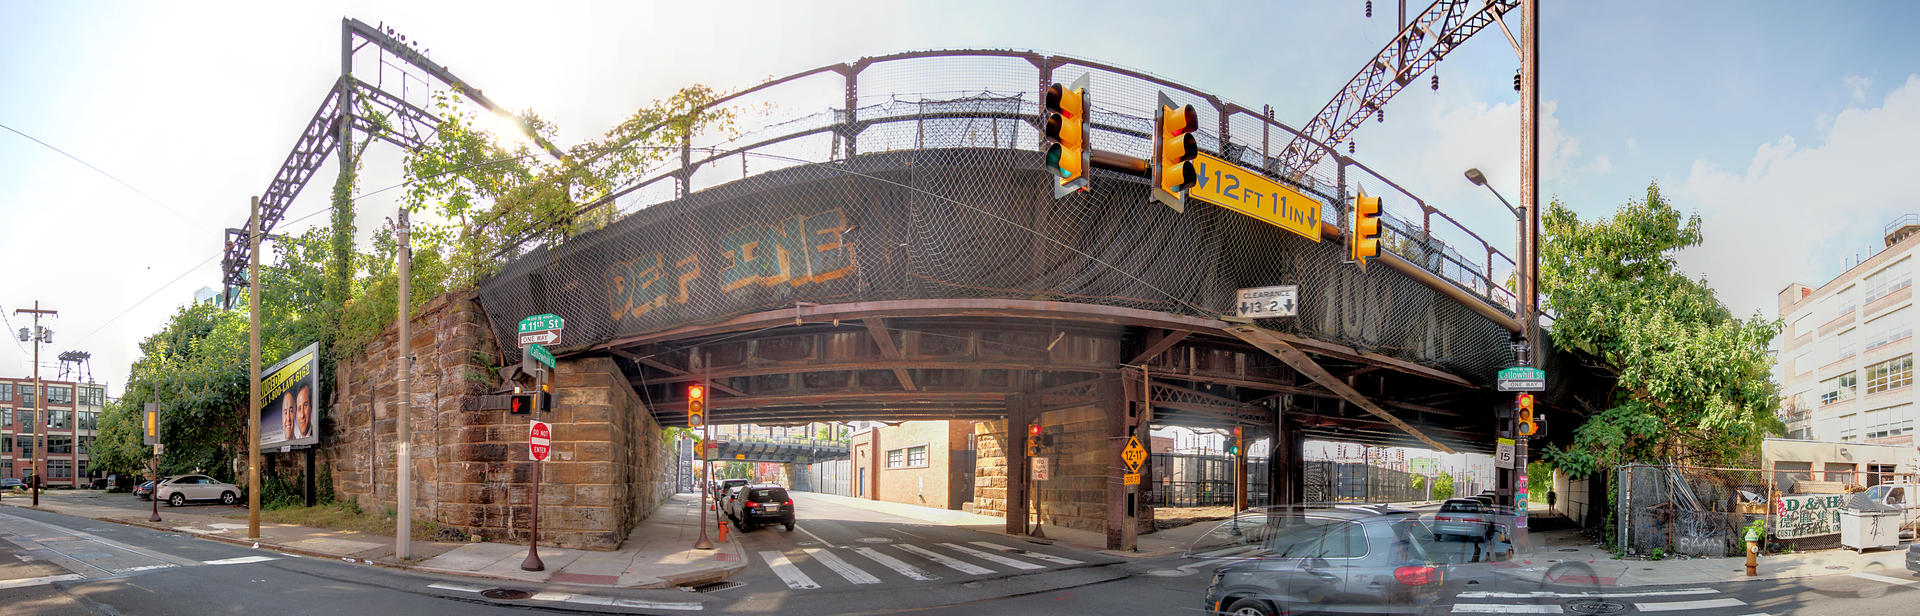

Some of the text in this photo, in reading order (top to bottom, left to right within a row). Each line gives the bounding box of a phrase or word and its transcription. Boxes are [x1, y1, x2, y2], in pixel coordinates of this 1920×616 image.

[1214, 170, 1304, 225] 12 FT 11 IN
[1243, 289, 1292, 299] CLEARANCE
[528, 320, 544, 331] 11th
[548, 319, 559, 329] St
[1500, 371, 1543, 380] Callowhill St
[268, 364, 310, 405] 1-800-LAW-6162
[1500, 452, 1511, 461] 15
[1785, 498, 1800, 511] D
[1805, 497, 1820, 511] &
[1825, 496, 1839, 509] H
